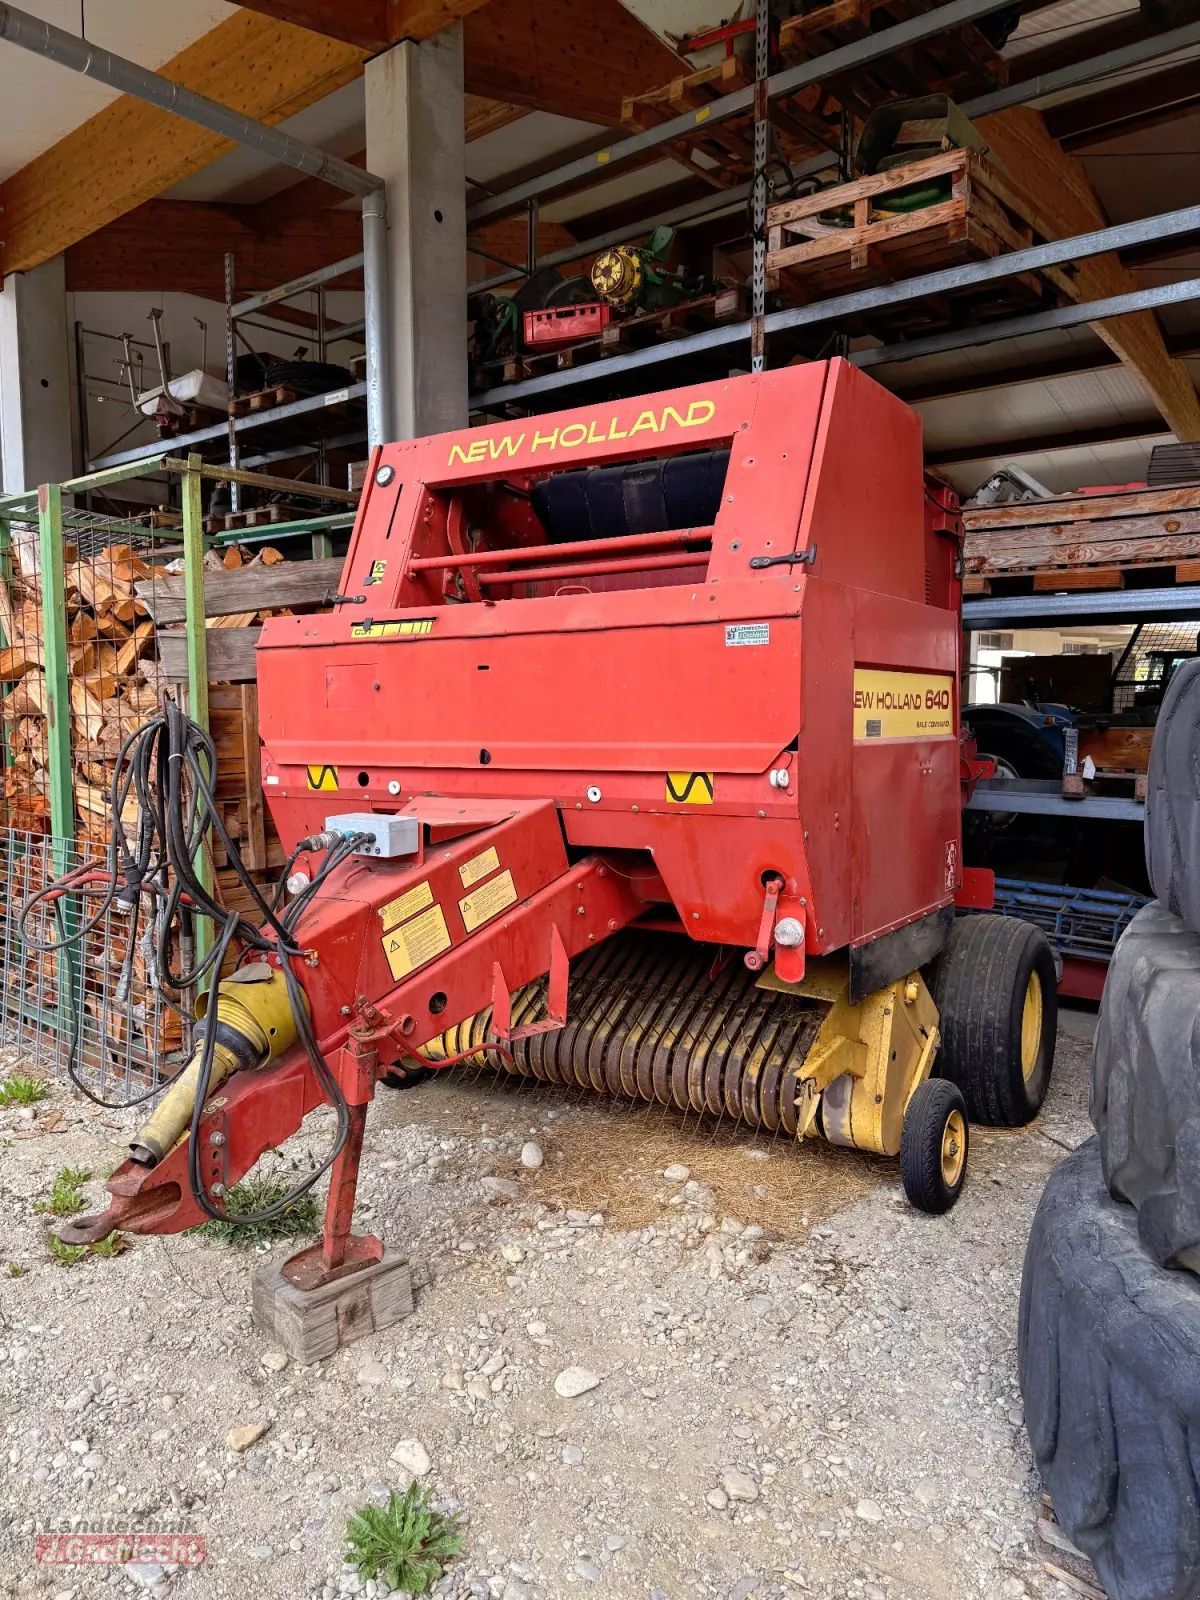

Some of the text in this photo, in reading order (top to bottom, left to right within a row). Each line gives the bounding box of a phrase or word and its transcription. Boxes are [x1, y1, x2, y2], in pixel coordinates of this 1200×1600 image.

[448, 400, 716, 466] NEW HOLLAND
[852, 689, 949, 710] EW HOLLAND 640
[928, 720, 950, 728] COMMAND
